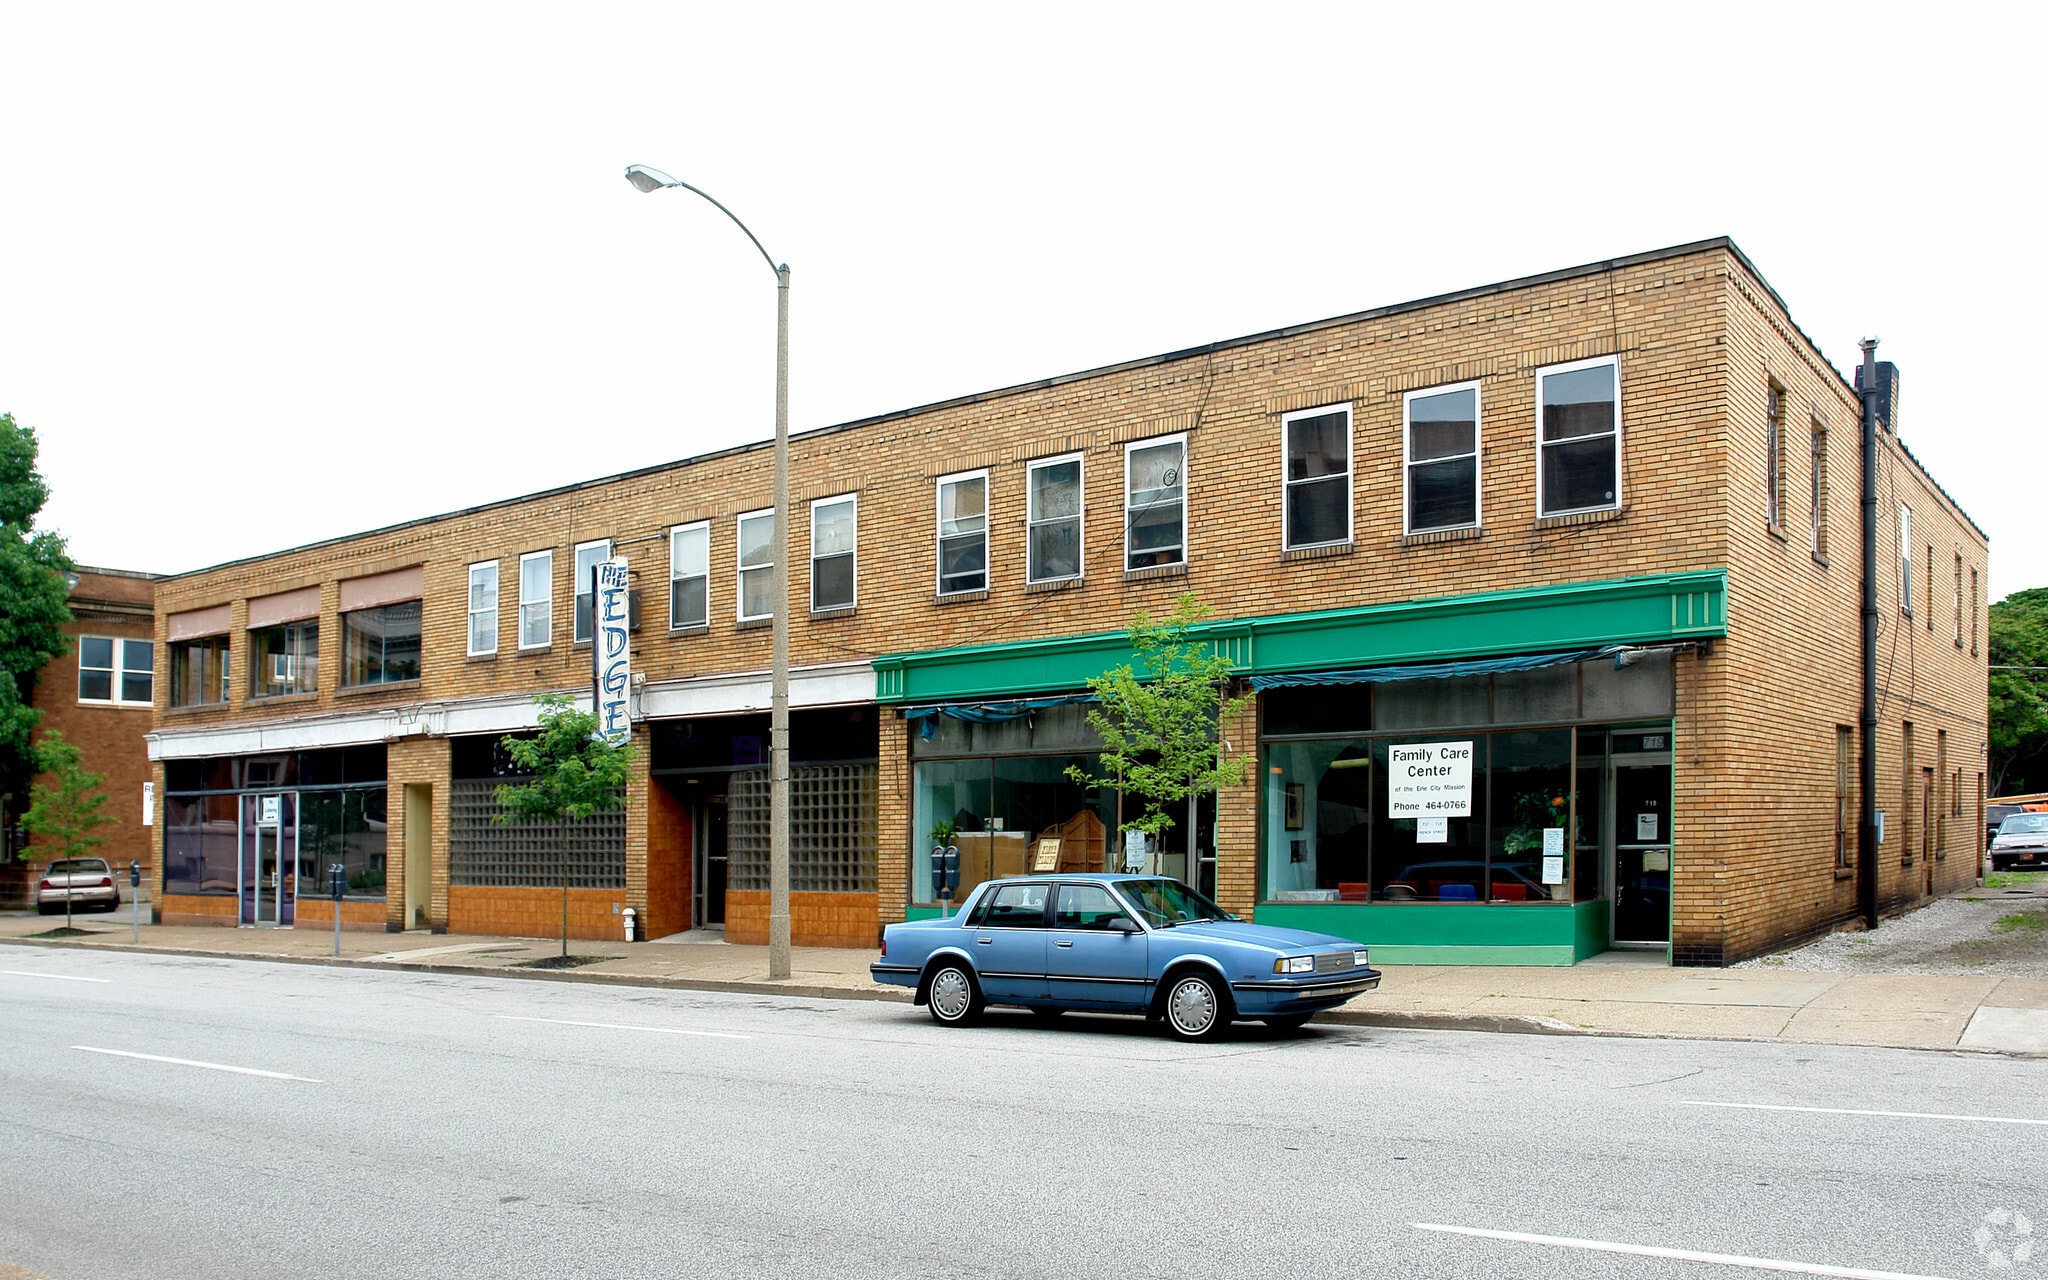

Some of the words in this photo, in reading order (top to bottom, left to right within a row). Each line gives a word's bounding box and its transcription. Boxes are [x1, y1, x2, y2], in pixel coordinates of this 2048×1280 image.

[598, 561, 628, 588] THE
[602, 587, 628, 735] EDGE
[1643, 736, 1664, 748] 719
[1393, 749, 1432, 762] Family
[1441, 748, 1469, 759] Care
[1408, 765, 1452, 777] Center
[1394, 802, 1420, 810] Phone
[1426, 801, 1466, 809] 464-0766
